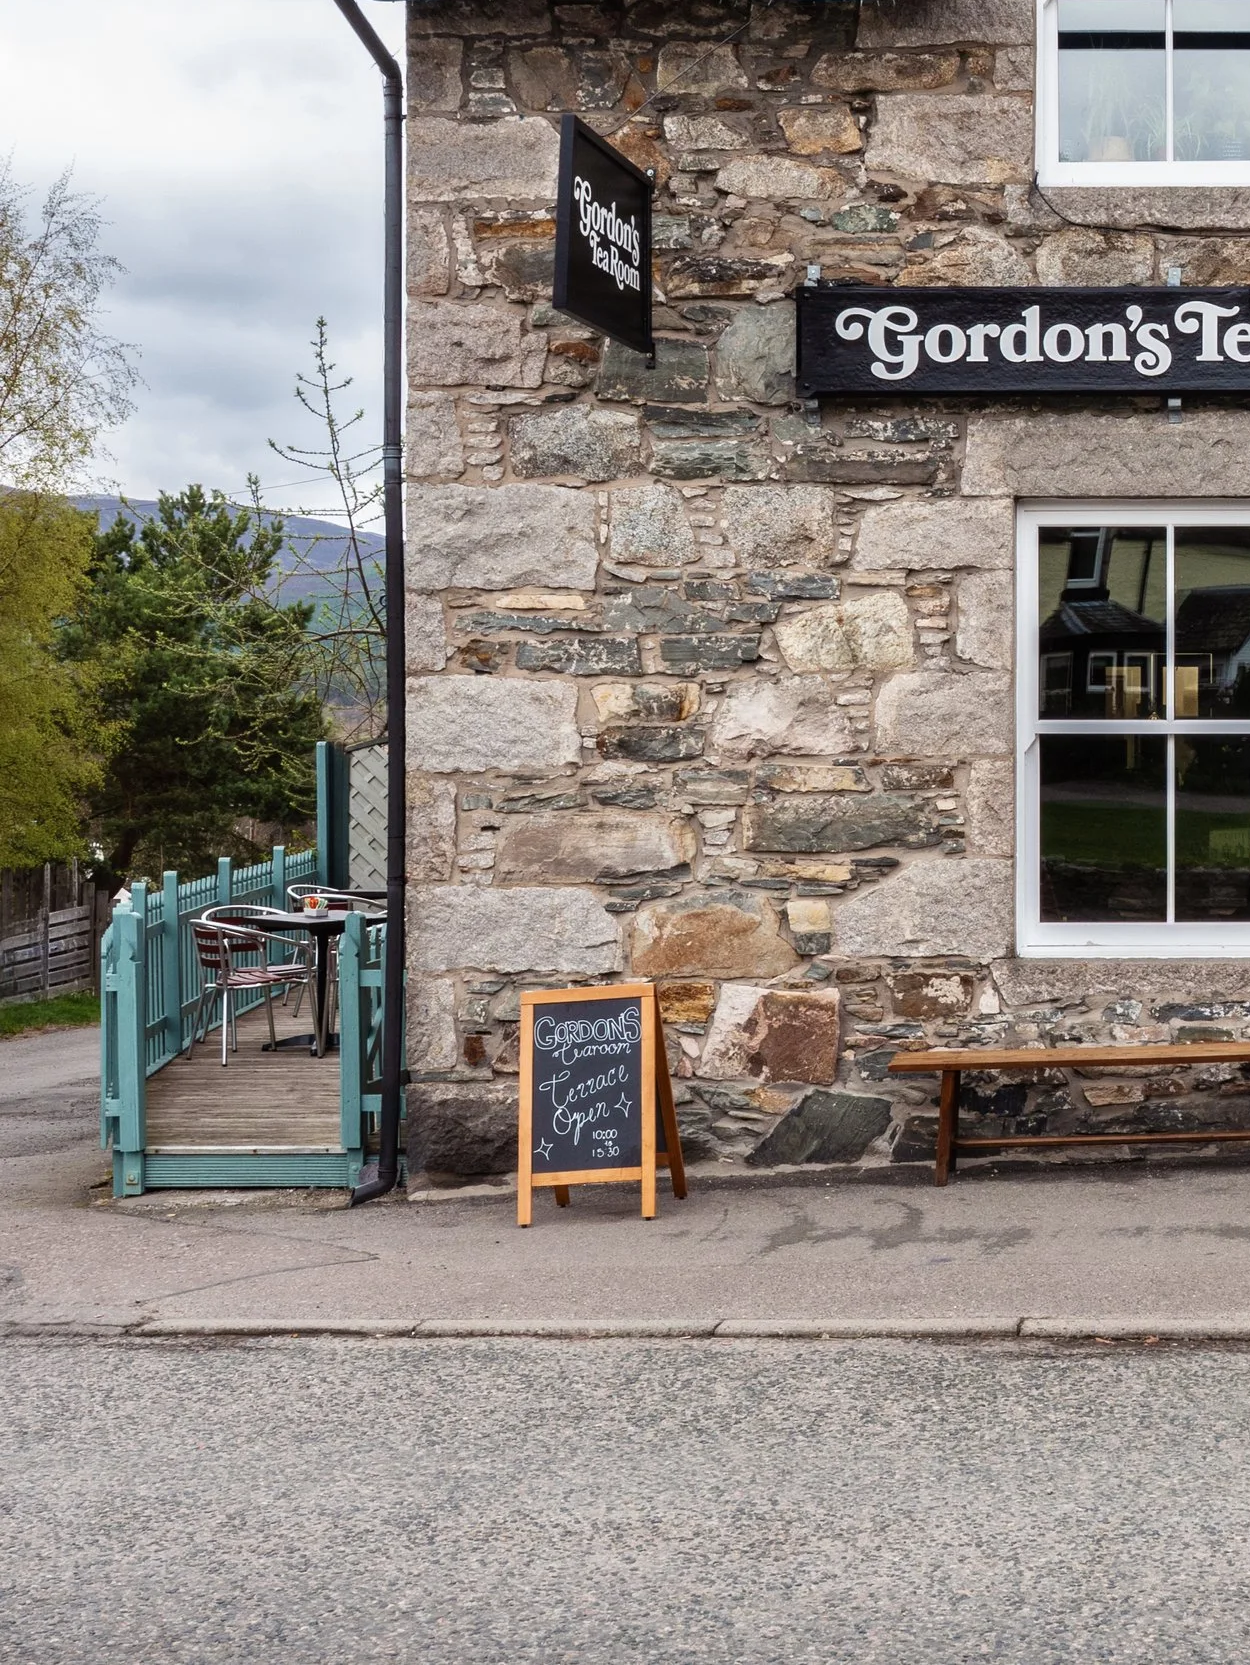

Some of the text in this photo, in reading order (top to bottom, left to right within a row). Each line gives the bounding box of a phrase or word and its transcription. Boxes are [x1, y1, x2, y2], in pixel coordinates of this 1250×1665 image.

[574, 175, 640, 266] Gordon's
[590, 230, 641, 291] Tea Room
[835, 305, 1173, 380] Gordon's
[539, 1065, 629, 1109] Terrace
[553, 1101, 610, 1146] Open
[592, 1129, 618, 1140] 10:00
